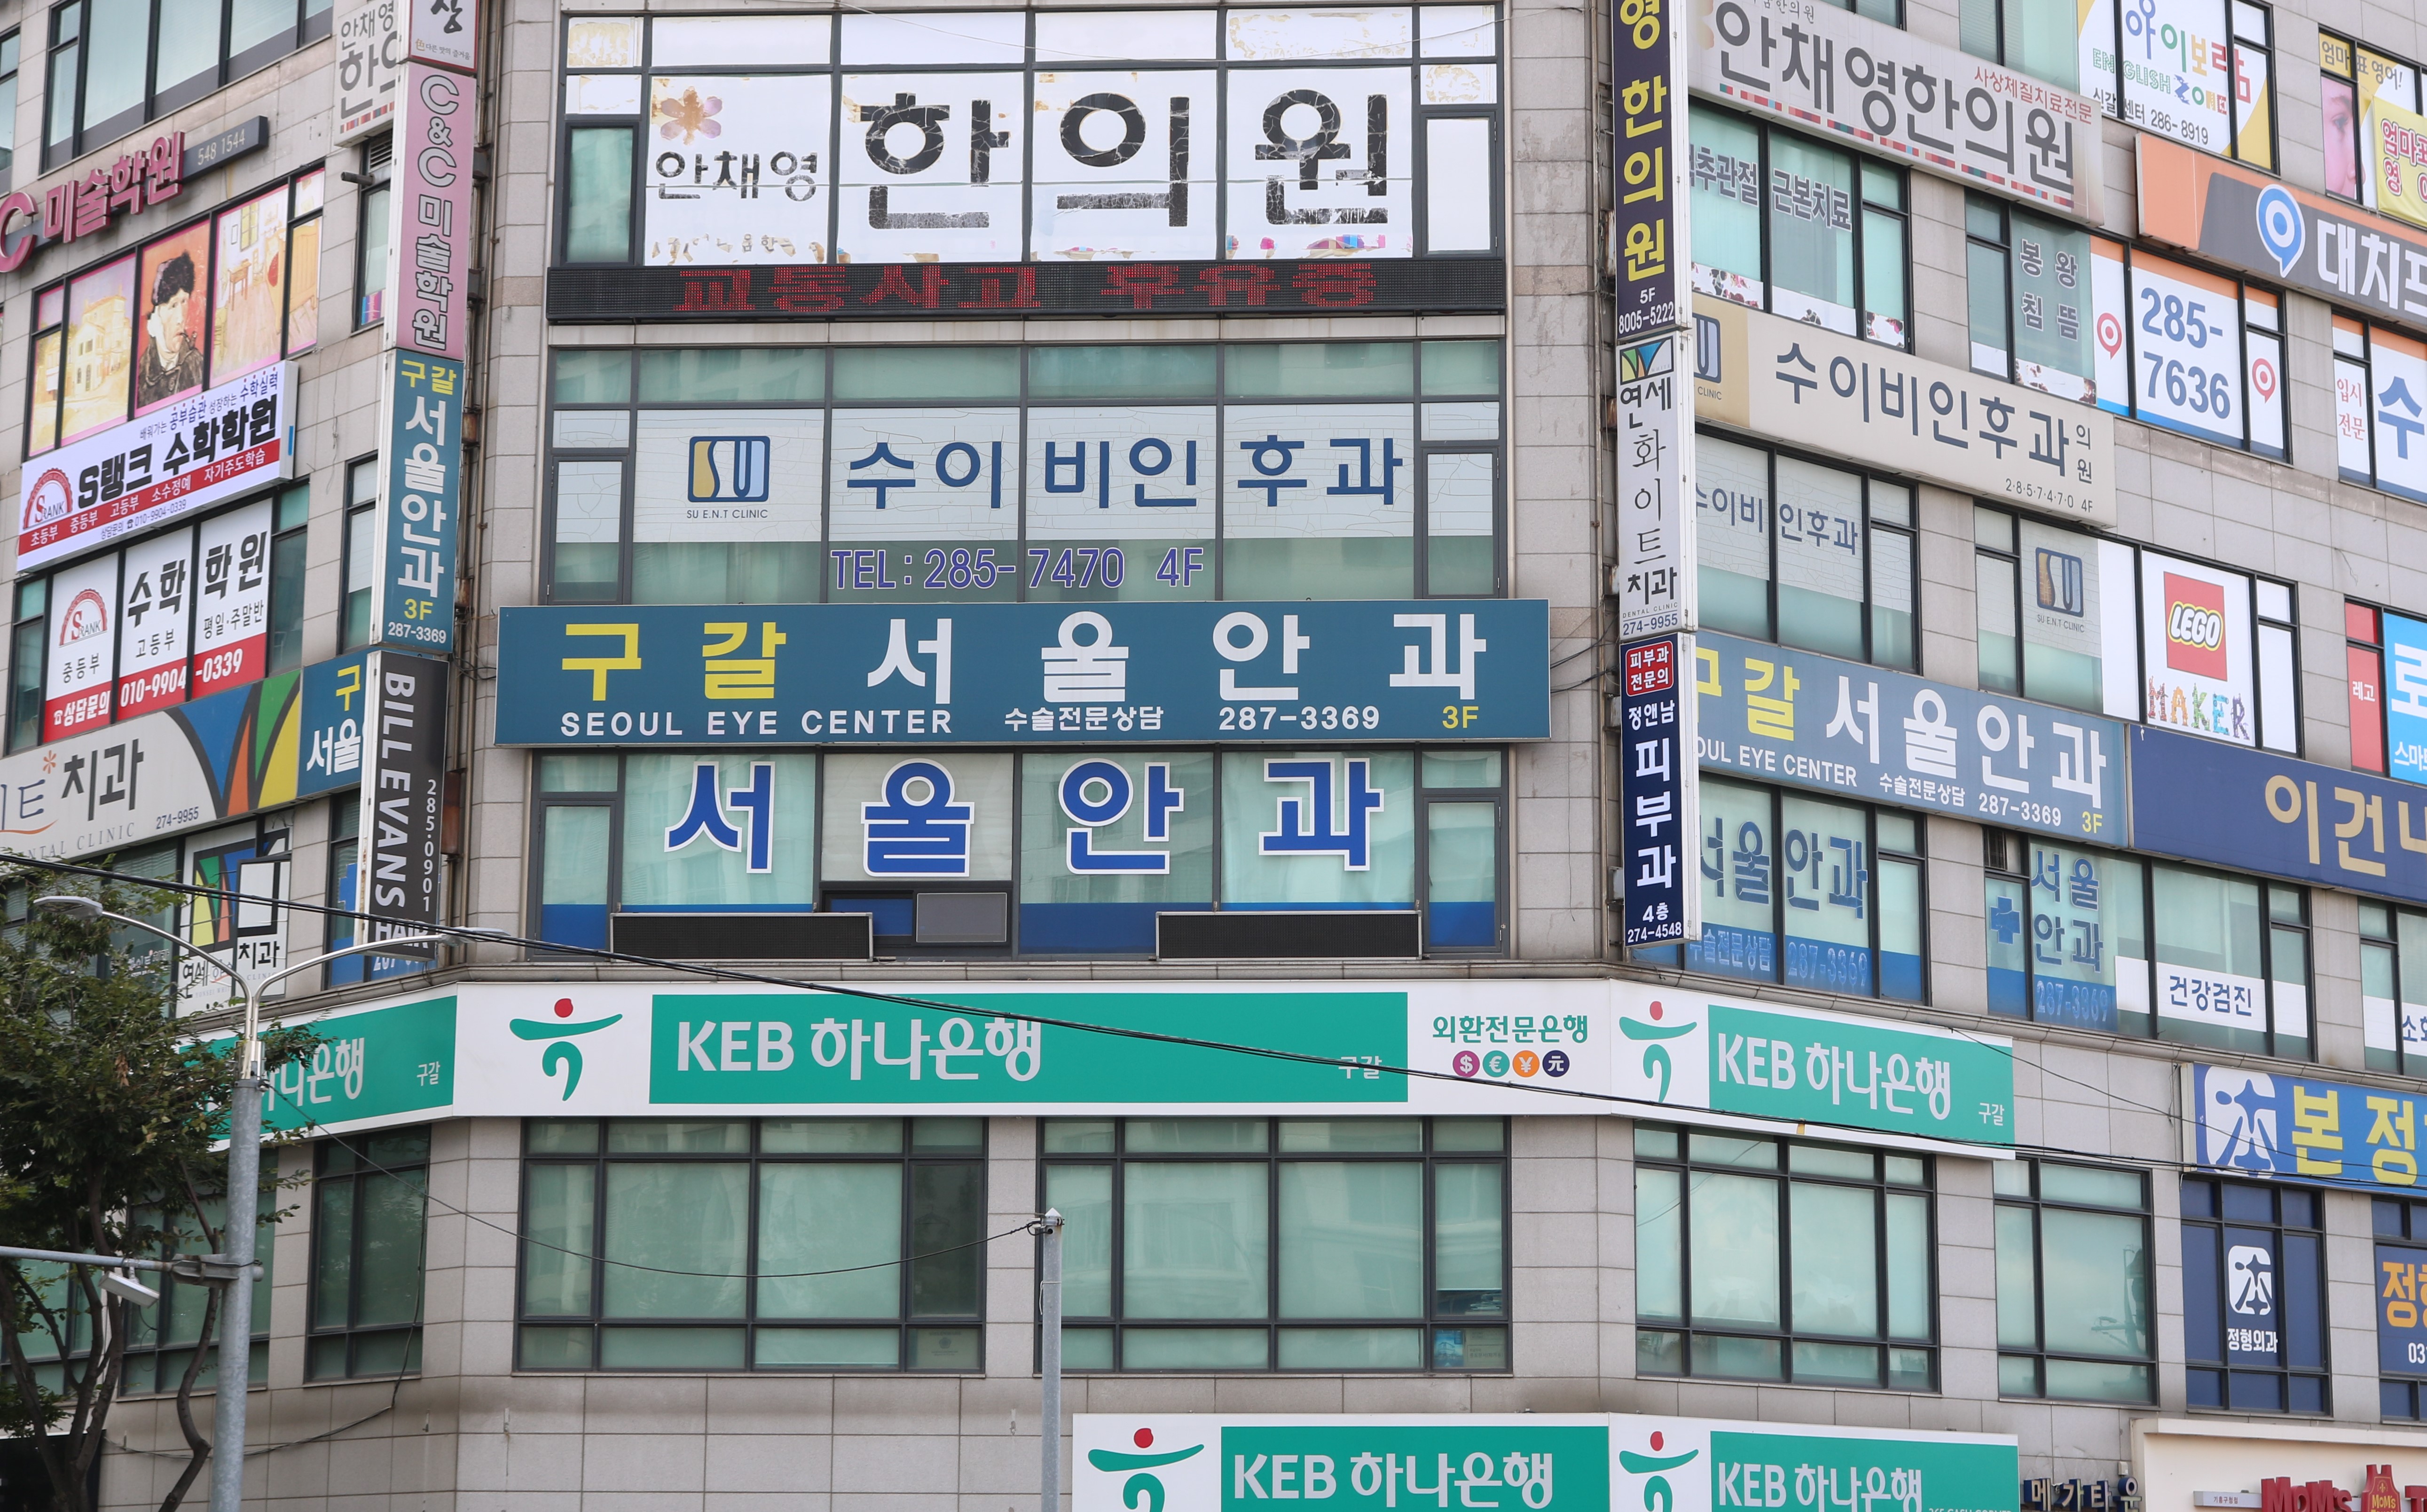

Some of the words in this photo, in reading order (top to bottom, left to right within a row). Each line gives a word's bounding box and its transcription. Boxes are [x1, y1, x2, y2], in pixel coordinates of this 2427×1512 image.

[341, 0, 393, 50] 안채영
[2093, 47, 2171, 94] ENGLISH
[1716, 1, 2074, 195] 안채영한의원
[1974, 65, 2092, 125] 사상체질치료전문
[197, 146, 216, 166] 548
[221, 128, 245, 156] 1544
[418, 74, 459, 188] C&C
[655, 151, 817, 202] 안채영
[860, 89, 1388, 229] 한의원
[1622, 75, 1667, 282] 한의원
[43, 131, 184, 243] 미술학원
[1771, 168, 1853, 233] 근본치료
[412, 194, 454, 352] 미술학원
[1100, 263, 1377, 309] 후유증
[1618, 301, 1674, 335] 8005-5222
[1640, 287, 1656, 305] 5F
[401, 359, 456, 395] 구갈
[1697, 386, 1722, 400] CLINIC
[2144, 351, 2231, 419] 7636
[2337, 378, 2362, 407] 입시
[170, 400, 207, 430] 공부습관
[209, 394, 237, 414] 성장하는
[239, 371, 278, 399] 수학실력
[1620, 376, 1672, 429] 연세
[1775, 343, 2069, 477] 수이비인후과
[2339, 413, 2366, 441] 전문
[78, 443, 152, 508] S랭크
[163, 393, 278, 476] 수학학원
[847, 434, 1403, 509] 수이비인후과
[30, 525, 58, 546] 초등부
[70, 510, 98, 533] 중등부
[110, 494, 140, 517] 고등부
[151, 475, 191, 502] 소수정예
[204, 447, 266, 483] 자기주도학습
[397, 396, 447, 598] 서울안과
[687, 509, 699, 519] SU
[732, 509, 769, 519] CLINIC
[1633, 429, 1666, 564] 화이트
[2081, 498, 2093, 513] 4F
[100, 521, 124, 541] 상담문의
[134, 499, 187, 527] 010-9904-0339
[127, 558, 186, 628] 수학
[204, 531, 267, 599] 학원
[1155, 547, 1204, 588] 4F
[1627, 566, 1677, 605] 치과
[404, 598, 433, 620] 3F
[1622, 608, 1649, 619] DENTAL
[1654, 602, 1678, 613] CLINIC
[1622, 613, 1678, 636] 274-9955
[2037, 614, 2045, 624] SU
[2063, 620, 2085, 634] CLINIC
[2169, 605, 2223, 650] LEGO
[135, 629, 175, 658] 고등부
[388, 622, 447, 644] 287-3369
[63, 652, 100, 684] 중등부
[562, 621, 786, 701] 구갈
[867, 611, 1487, 705] 서울안과
[1630, 646, 1669, 669] 피부과
[1630, 667, 1670, 690] 전문의
[63, 689, 111, 727] 상담문의
[2147, 676, 2250, 741] MAKER
[2352, 681, 2375, 702] 레고
[561, 711, 683, 737] SEOUL
[707, 710, 777, 735] EYE
[801, 709, 952, 734] CENTER
[1004, 706, 1164, 732] 수술전문상담
[1219, 705, 1380, 731] 287-3369
[1441, 705, 1478, 729] 3F
[1629, 699, 1675, 731] 정앤남
[306, 718, 364, 776] 서울
[1826, 676, 2107, 809] 서울안과
[62, 738, 144, 821] 치과
[1740, 745, 1775, 772] EYE
[1783, 753, 1857, 788] CENTER
[156, 806, 199, 830] 274-9955
[663, 757, 1385, 878] 서울안과
[1636, 737, 1676, 889] 피부과
[1880, 772, 1965, 808] 수술전문상담
[1979, 793, 2062, 828] 287-3369
[2082, 811, 2103, 835] 3F
[78, 823, 135, 850] CLINIC
[2031, 849, 2099, 911] 서울
[1628, 921, 1681, 943] 274-4548
[1642, 902, 1669, 923] 4층
[238, 941, 279, 970] 치과
[1788, 941, 1868, 987] 287-3369
[2034, 913, 2104, 973] 안과
[2036, 979, 2108, 1023] 287-3369
[2169, 975, 2253, 1018] 건강검진
[678, 1020, 794, 1072] KEB
[810, 1017, 1042, 1082] 하나은행
[1338, 1055, 1383, 1080] 구갈
[1432, 1014, 1588, 1044] 외환전문은행
[268, 1037, 365, 1111] 나은행
[416, 1060, 440, 1086] 구갈
[1719, 1033, 1796, 1090] KEB
[1806, 1042, 1951, 1121] 하나은행
[1978, 1102, 2005, 1127] 구갈
[2228, 1328, 2278, 1353] 정형외과
[2408, 1342, 2427, 1364] 03
[1235, 1454, 1336, 1500] KEB
[1351, 1451, 1553, 1510] 하나은행
[1718, 1462, 1787, 1508] KEB
[1795, 1463, 1922, 1512] 하나은행
[2213, 1496, 2238, 1505] 기흥구청점
